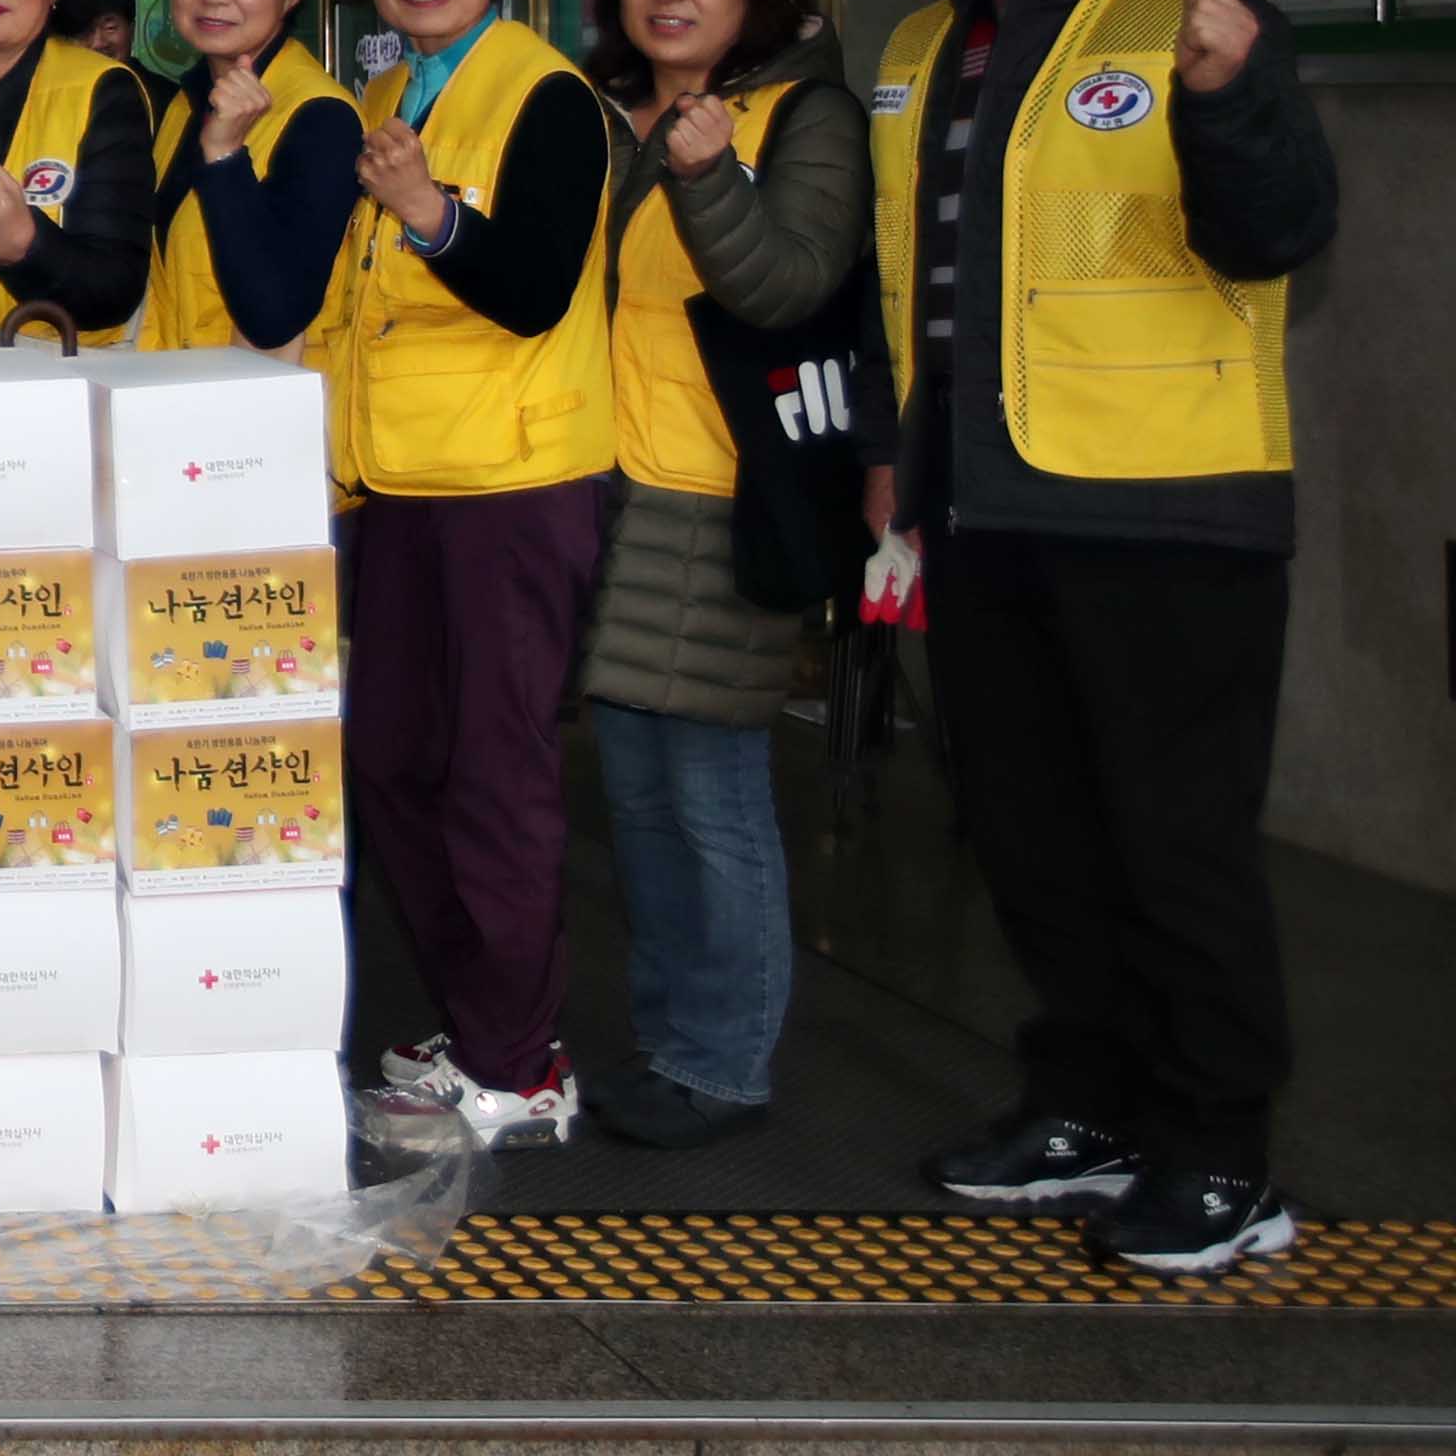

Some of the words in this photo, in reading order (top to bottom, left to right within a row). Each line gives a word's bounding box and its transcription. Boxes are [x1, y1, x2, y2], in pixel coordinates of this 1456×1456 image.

[768, 350, 857, 442] FIL
[148, 579, 307, 625] 나눔션샤인
[153, 748, 312, 792] 나눔션샤인
